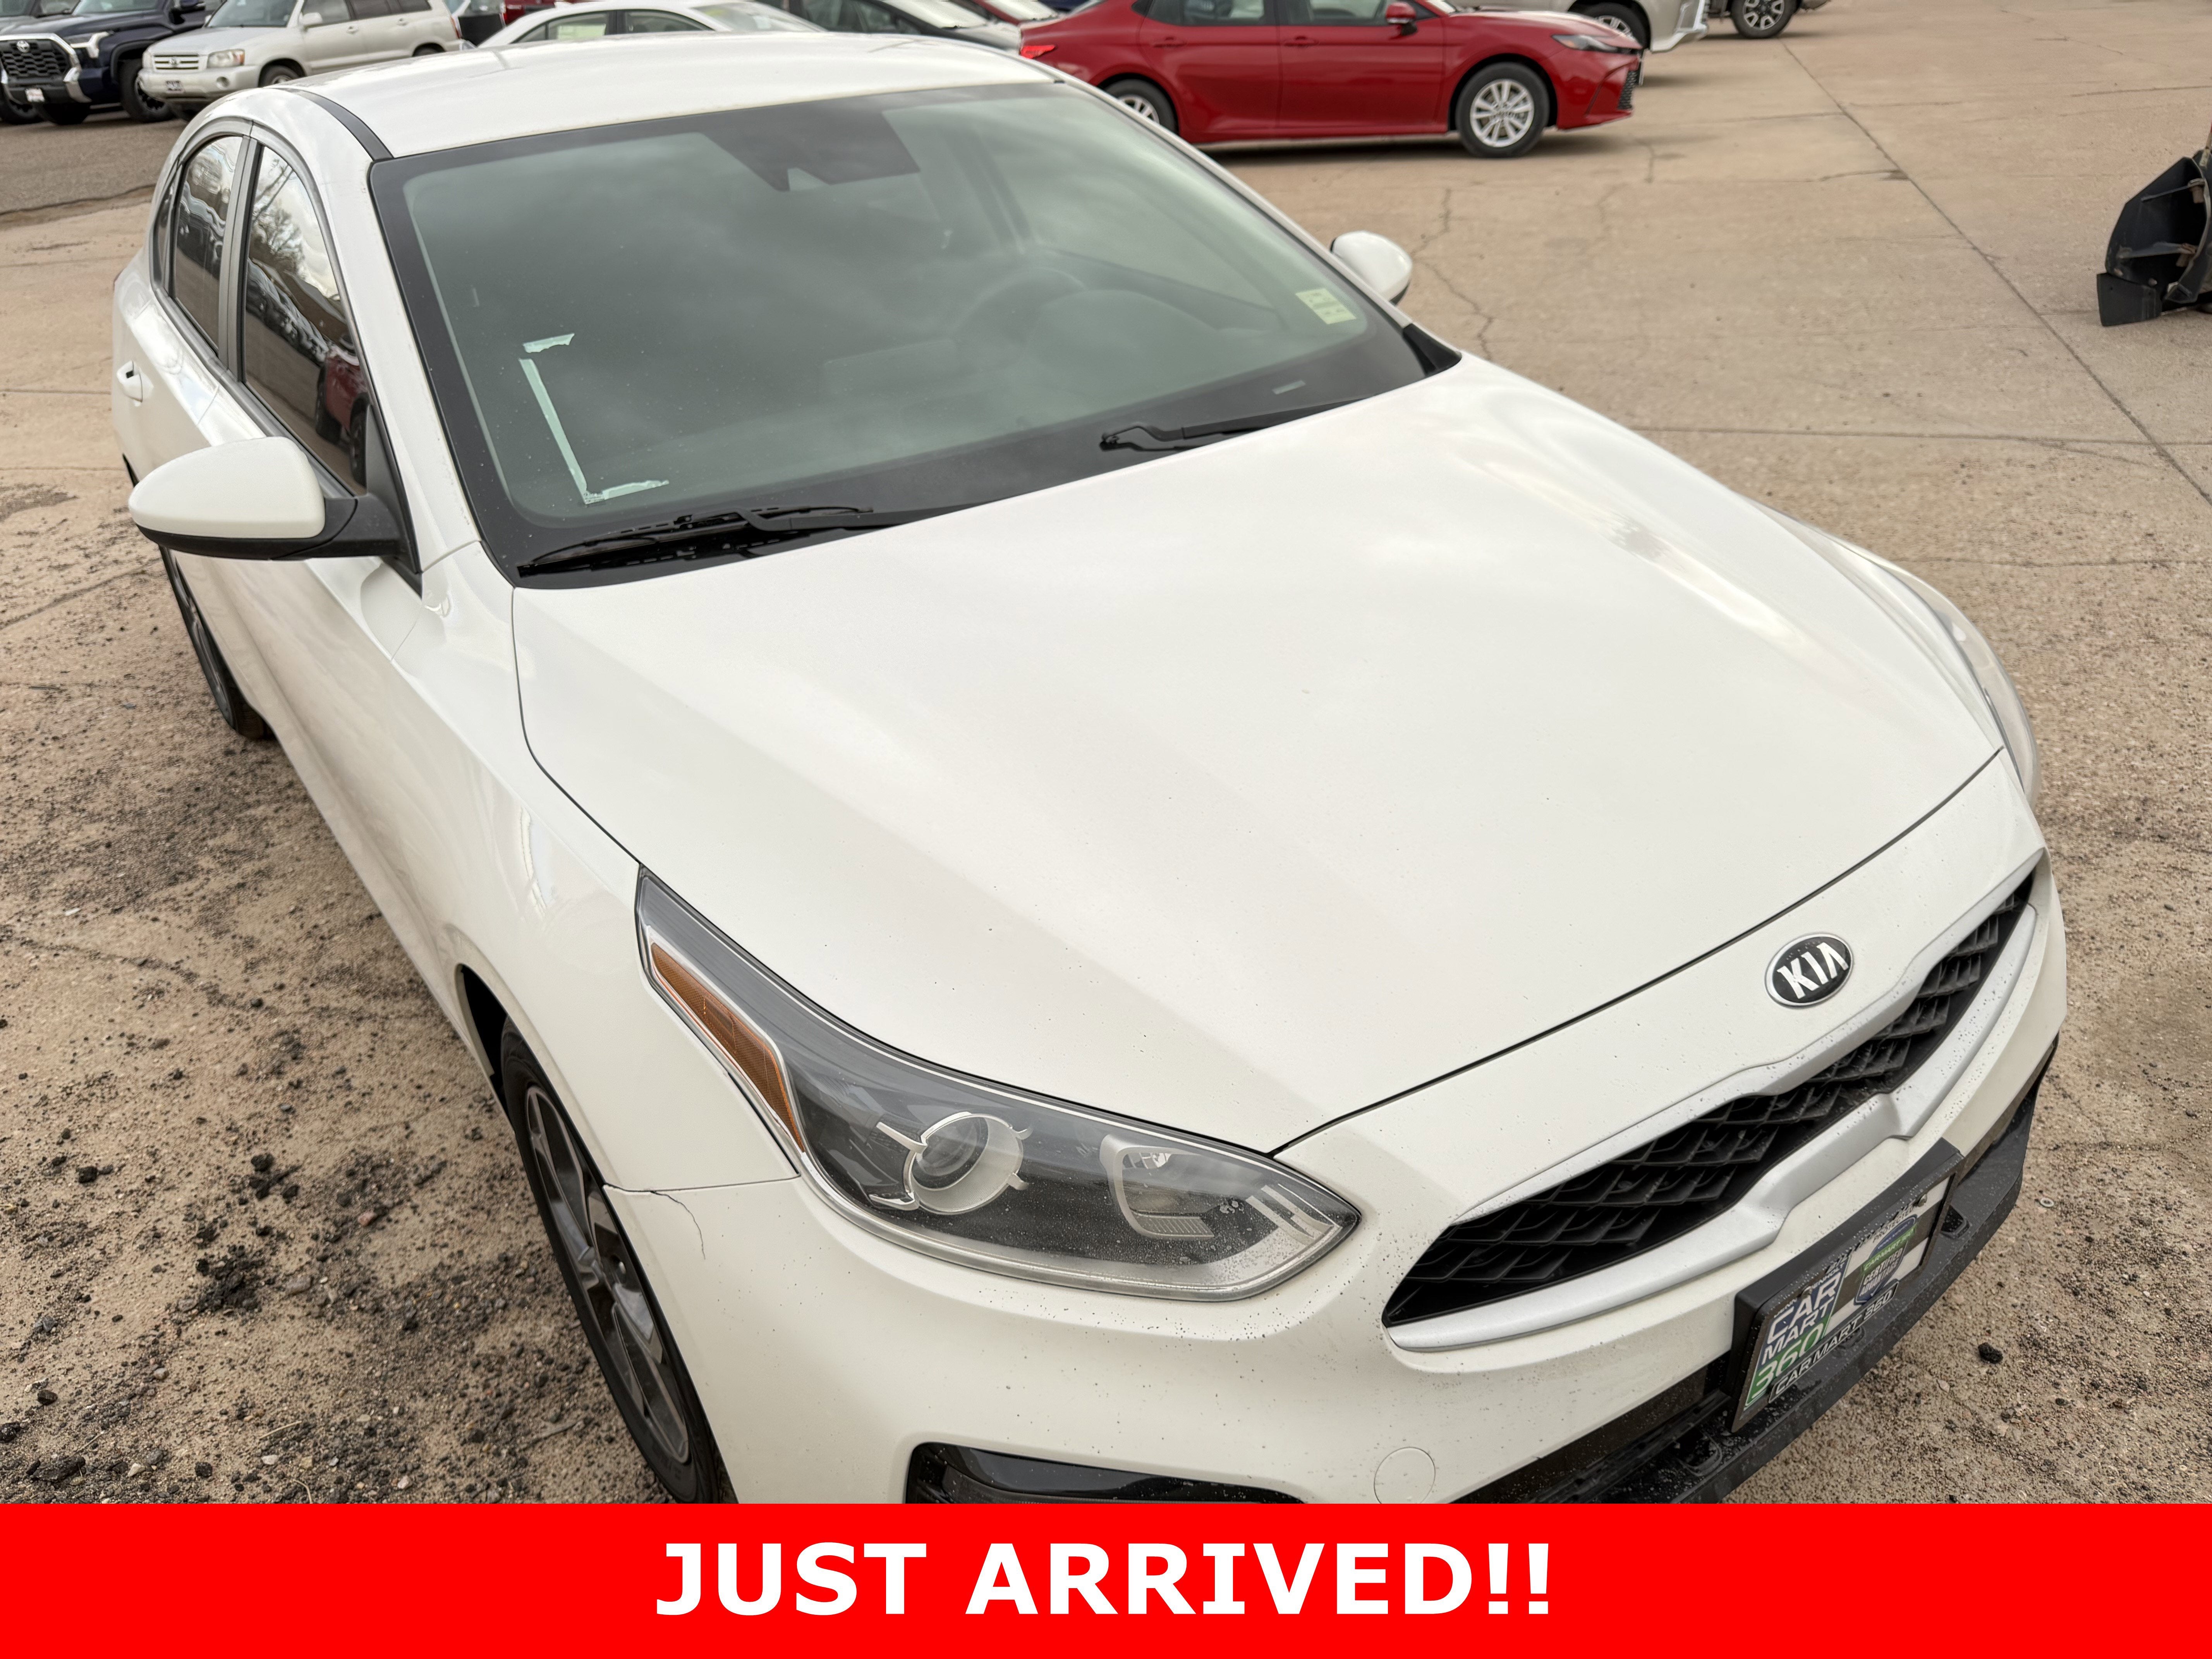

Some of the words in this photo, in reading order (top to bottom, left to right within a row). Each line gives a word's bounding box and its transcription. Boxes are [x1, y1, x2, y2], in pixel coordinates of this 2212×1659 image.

[1777, 942, 1849, 999] KIA
[1859, 1258, 1900, 1297] ADVANTAGE
[1863, 1248, 1903, 1285] CERTIFIED
[1762, 1297, 1834, 1365] MART
[1767, 1272, 1841, 1345] CAR
[1776, 1357, 1812, 1394] CAR
[1813, 1314, 1862, 1363] MART
[1863, 1289, 1893, 1320] 360
[1752, 1323, 1824, 1399] 360
